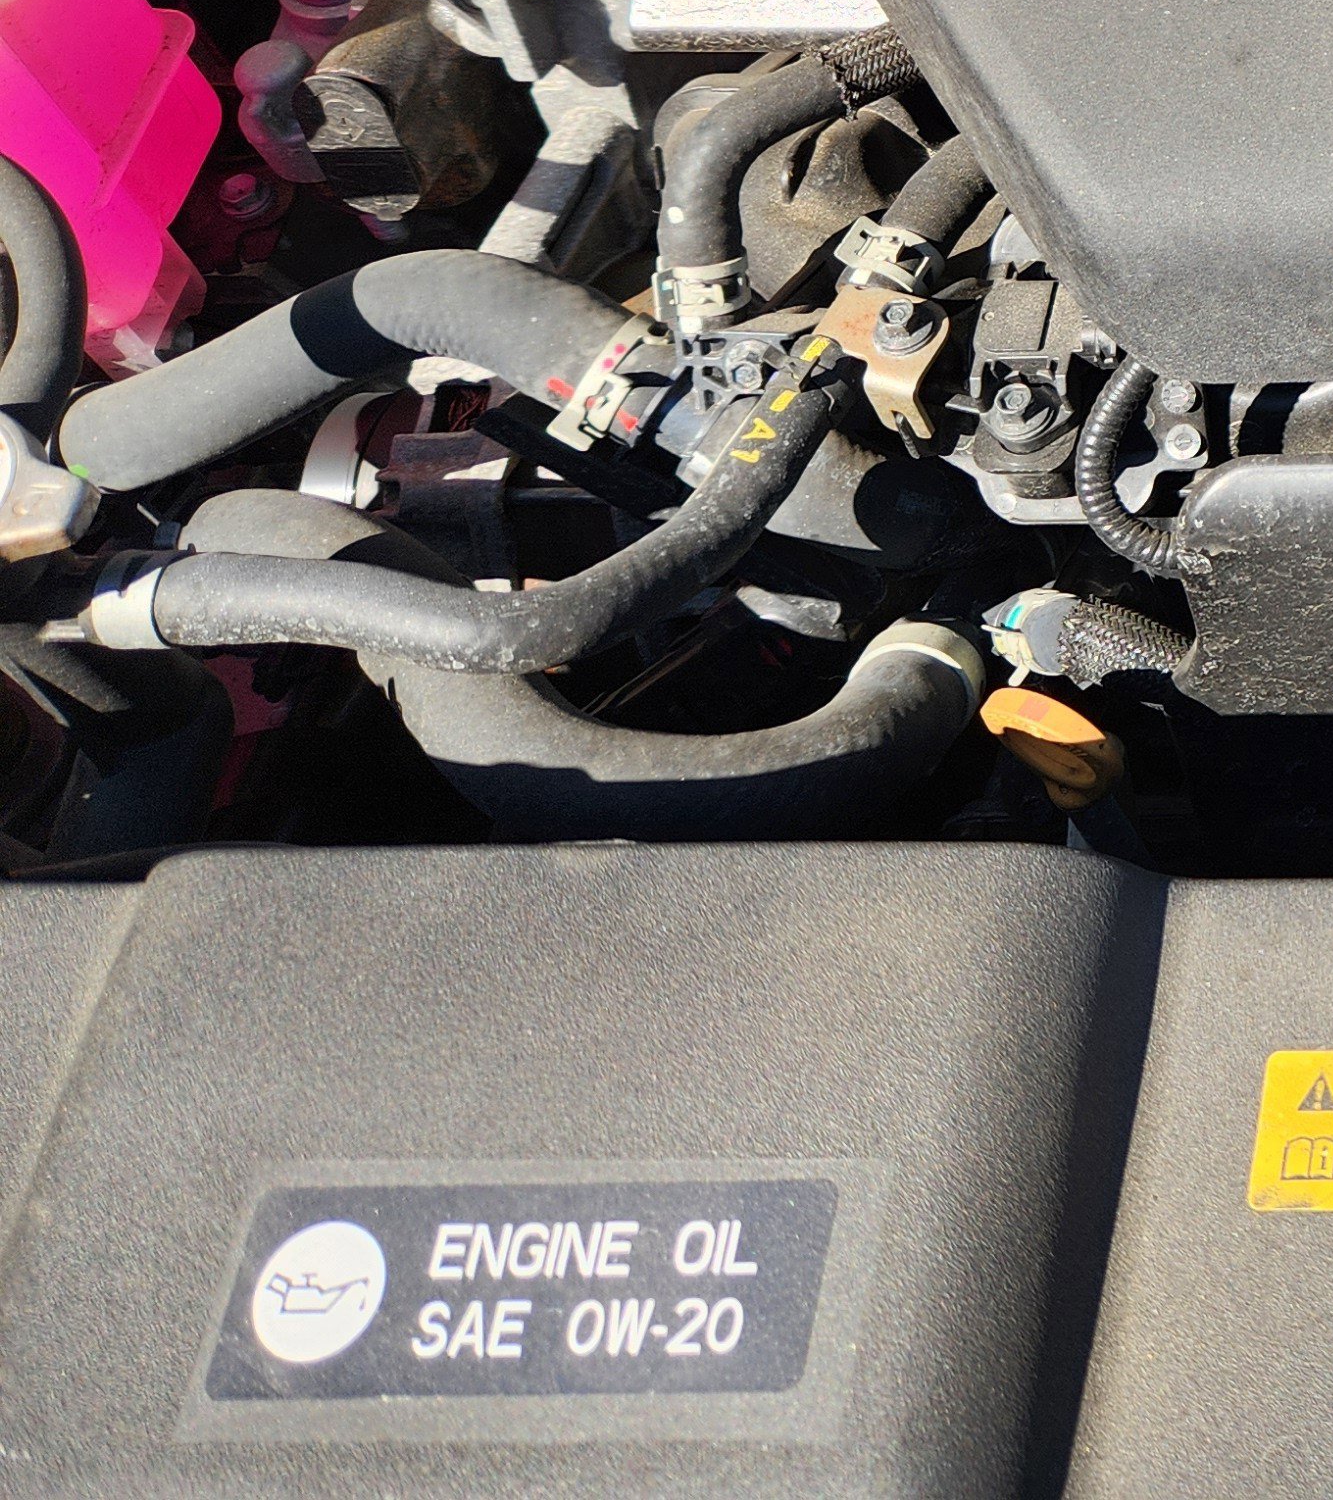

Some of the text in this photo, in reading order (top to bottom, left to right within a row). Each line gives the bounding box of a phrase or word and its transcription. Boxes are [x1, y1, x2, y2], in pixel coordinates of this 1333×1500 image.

[427, 1219, 758, 1280] ENGINE OIL
[411, 1297, 744, 1359] SAE 0W-20
